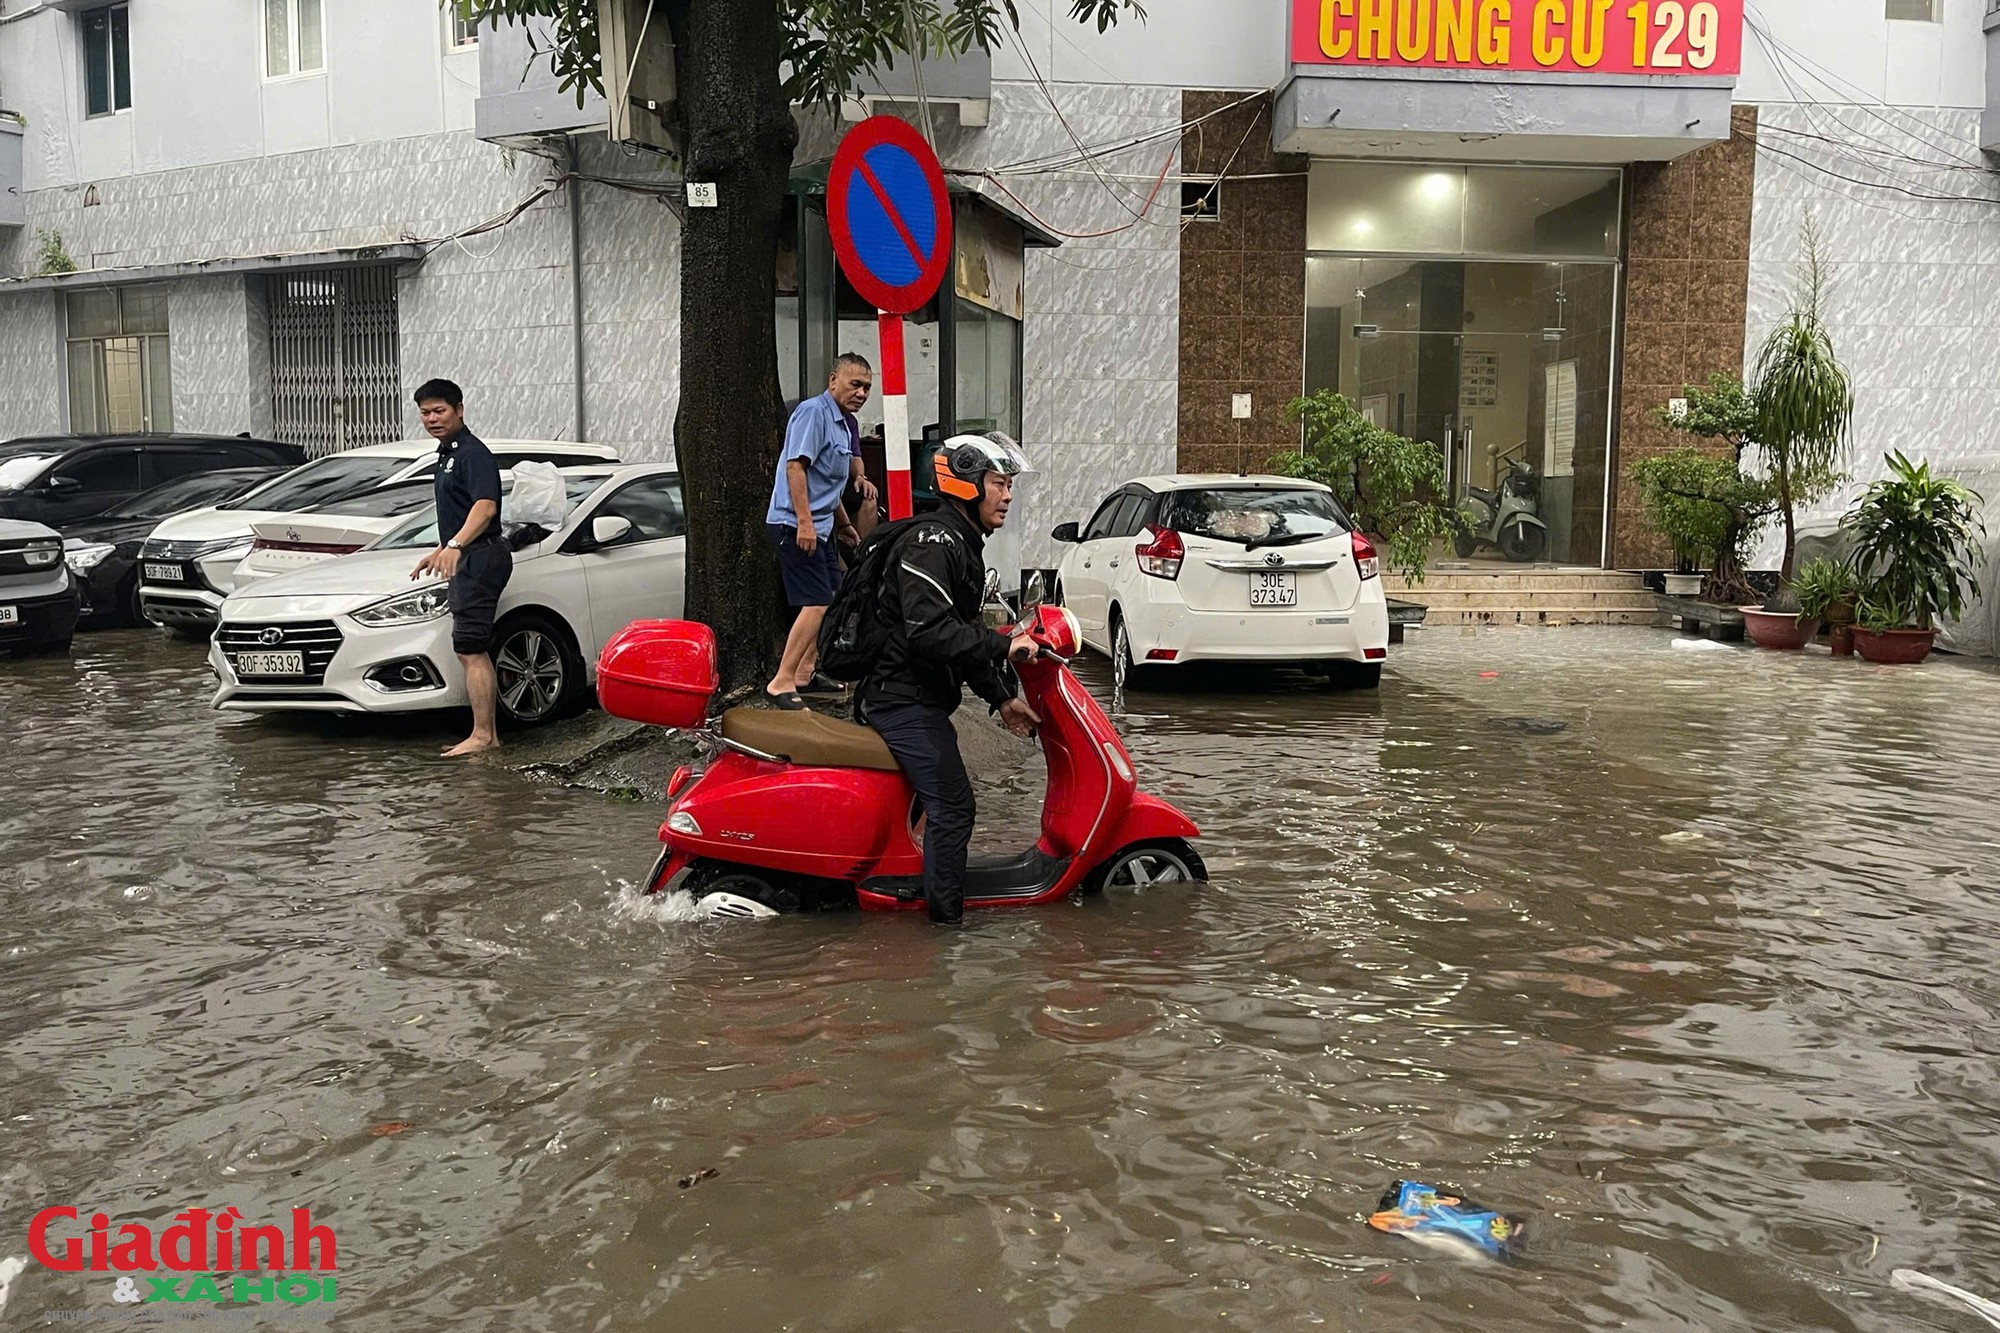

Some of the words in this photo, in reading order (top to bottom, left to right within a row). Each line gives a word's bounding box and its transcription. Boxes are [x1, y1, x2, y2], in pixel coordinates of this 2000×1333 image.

[1318, 0, 1511, 64] CHUNG
[1531, 0, 1614, 67] CƯ
[1626, 1, 1719, 69] 129
[695, 186, 709, 197] 85
[1261, 573, 1285, 588] 30E
[1252, 589, 1294, 603] 373.47
[239, 655, 302, 672] 30F-353.92
